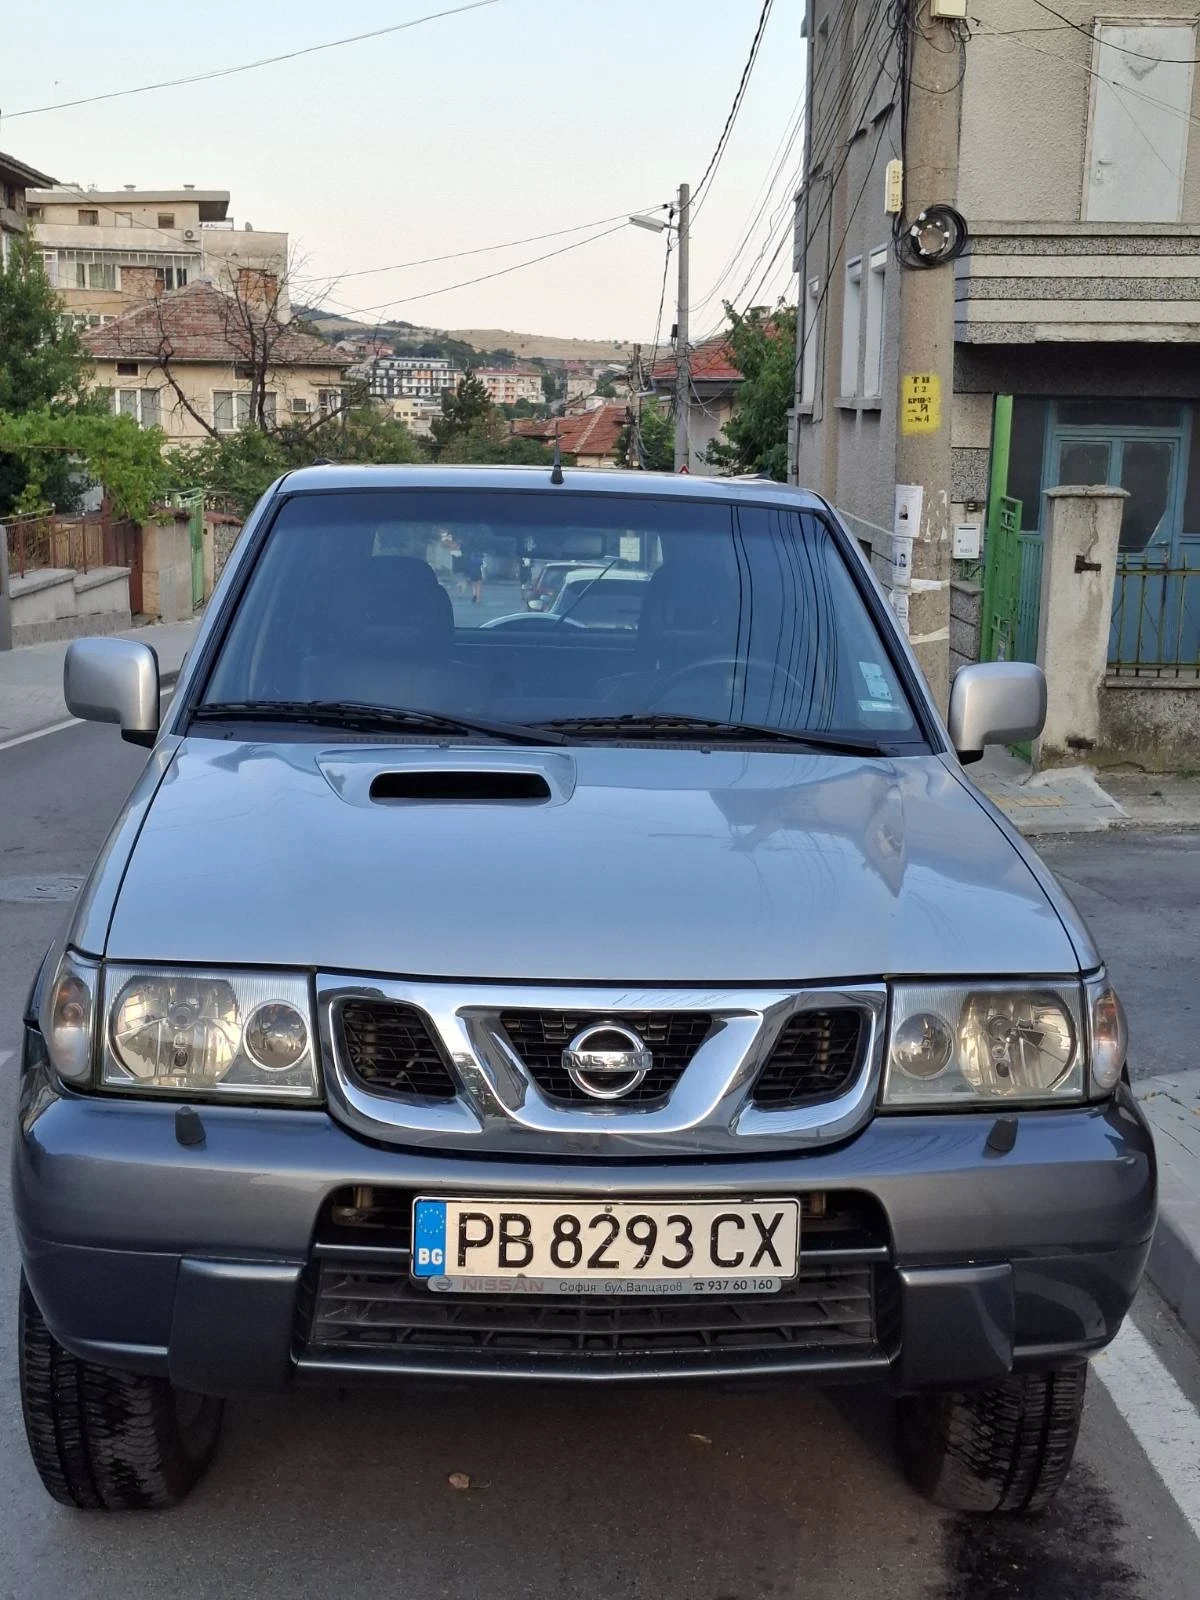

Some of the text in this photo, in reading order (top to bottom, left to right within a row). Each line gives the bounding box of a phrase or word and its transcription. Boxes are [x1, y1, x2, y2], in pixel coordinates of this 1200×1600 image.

[570, 1052, 641, 1068] NISSAN
[457, 1212, 785, 1269] PB 8293 CX
[418, 1247, 443, 1265] BG
[462, 1279, 545, 1292] NISSAN
[559, 1281, 597, 1293] София
[708, 1279, 729, 1291] 937
[733, 1279, 748, 1291] 60
[752, 1279, 773, 1290] 160
